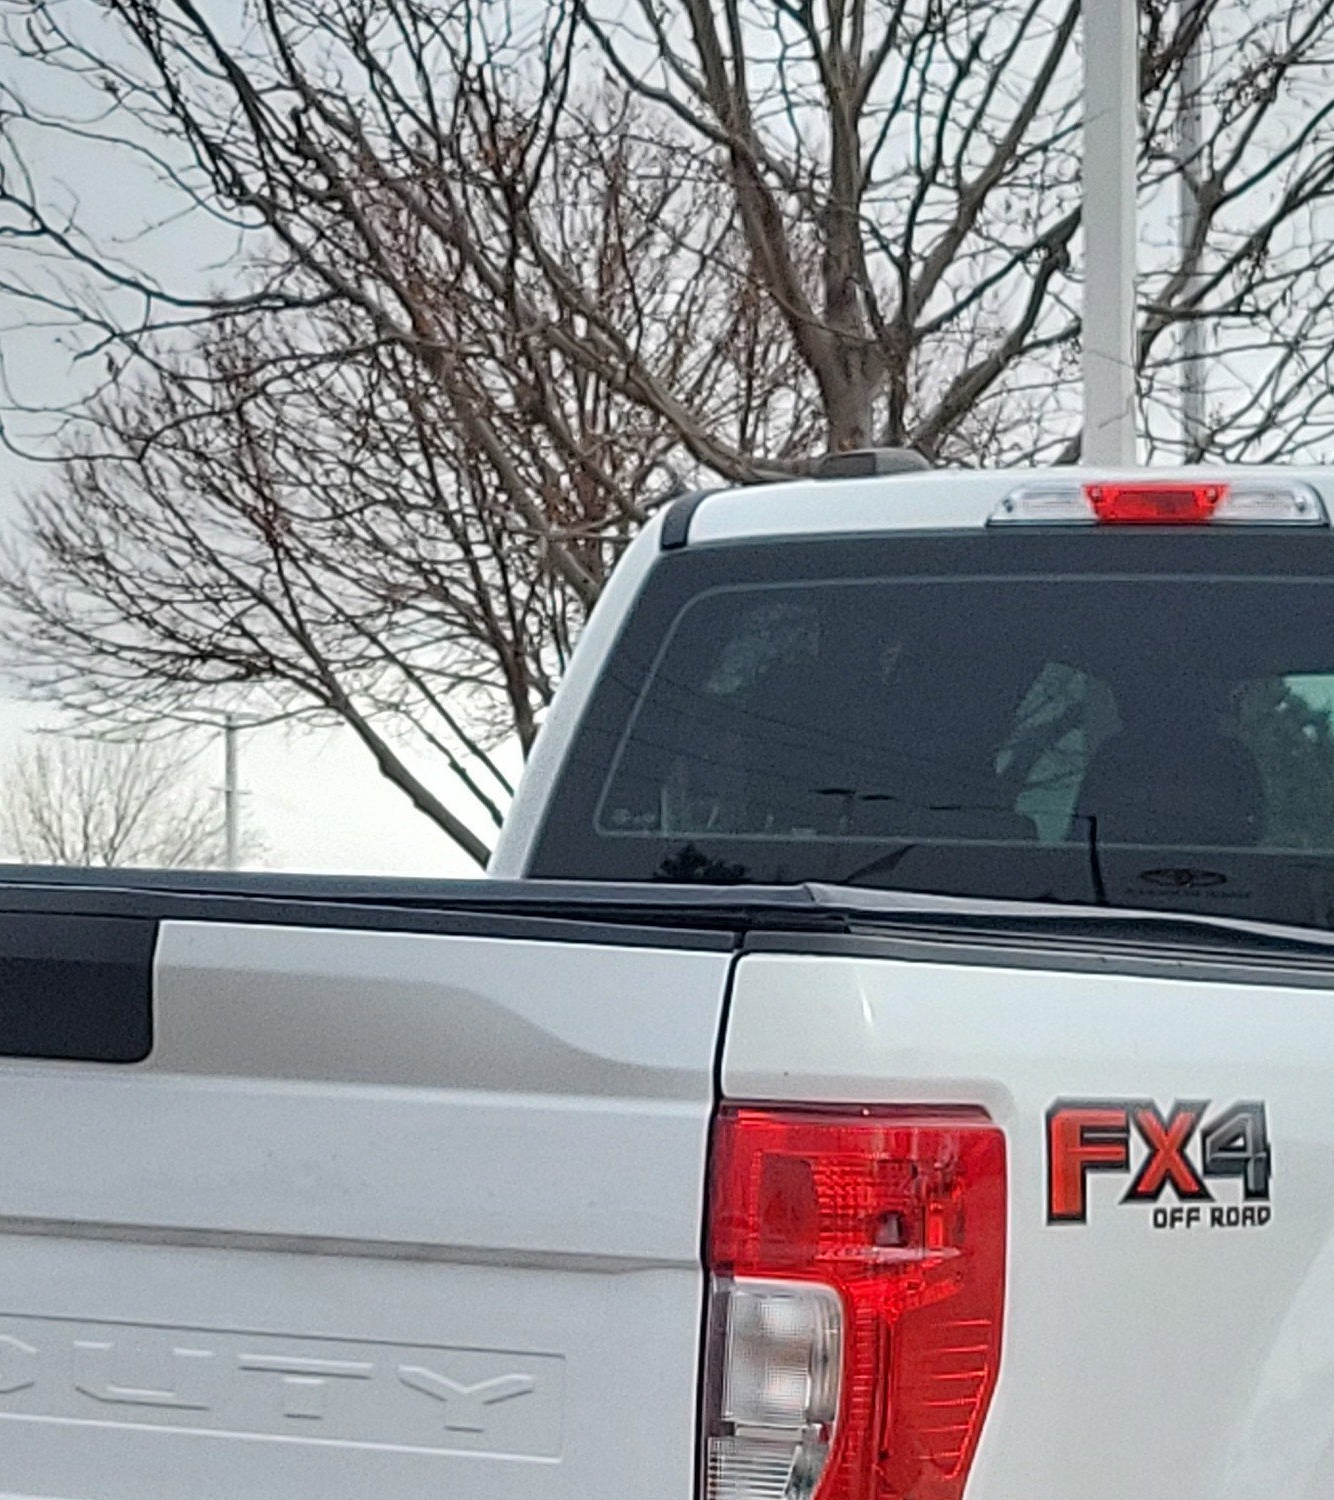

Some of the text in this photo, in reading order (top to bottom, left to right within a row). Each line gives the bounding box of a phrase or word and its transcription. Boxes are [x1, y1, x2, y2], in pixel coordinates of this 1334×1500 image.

[1045, 1097, 1271, 1226] FX4
[1153, 1207, 1271, 1228] OFF ROAD
